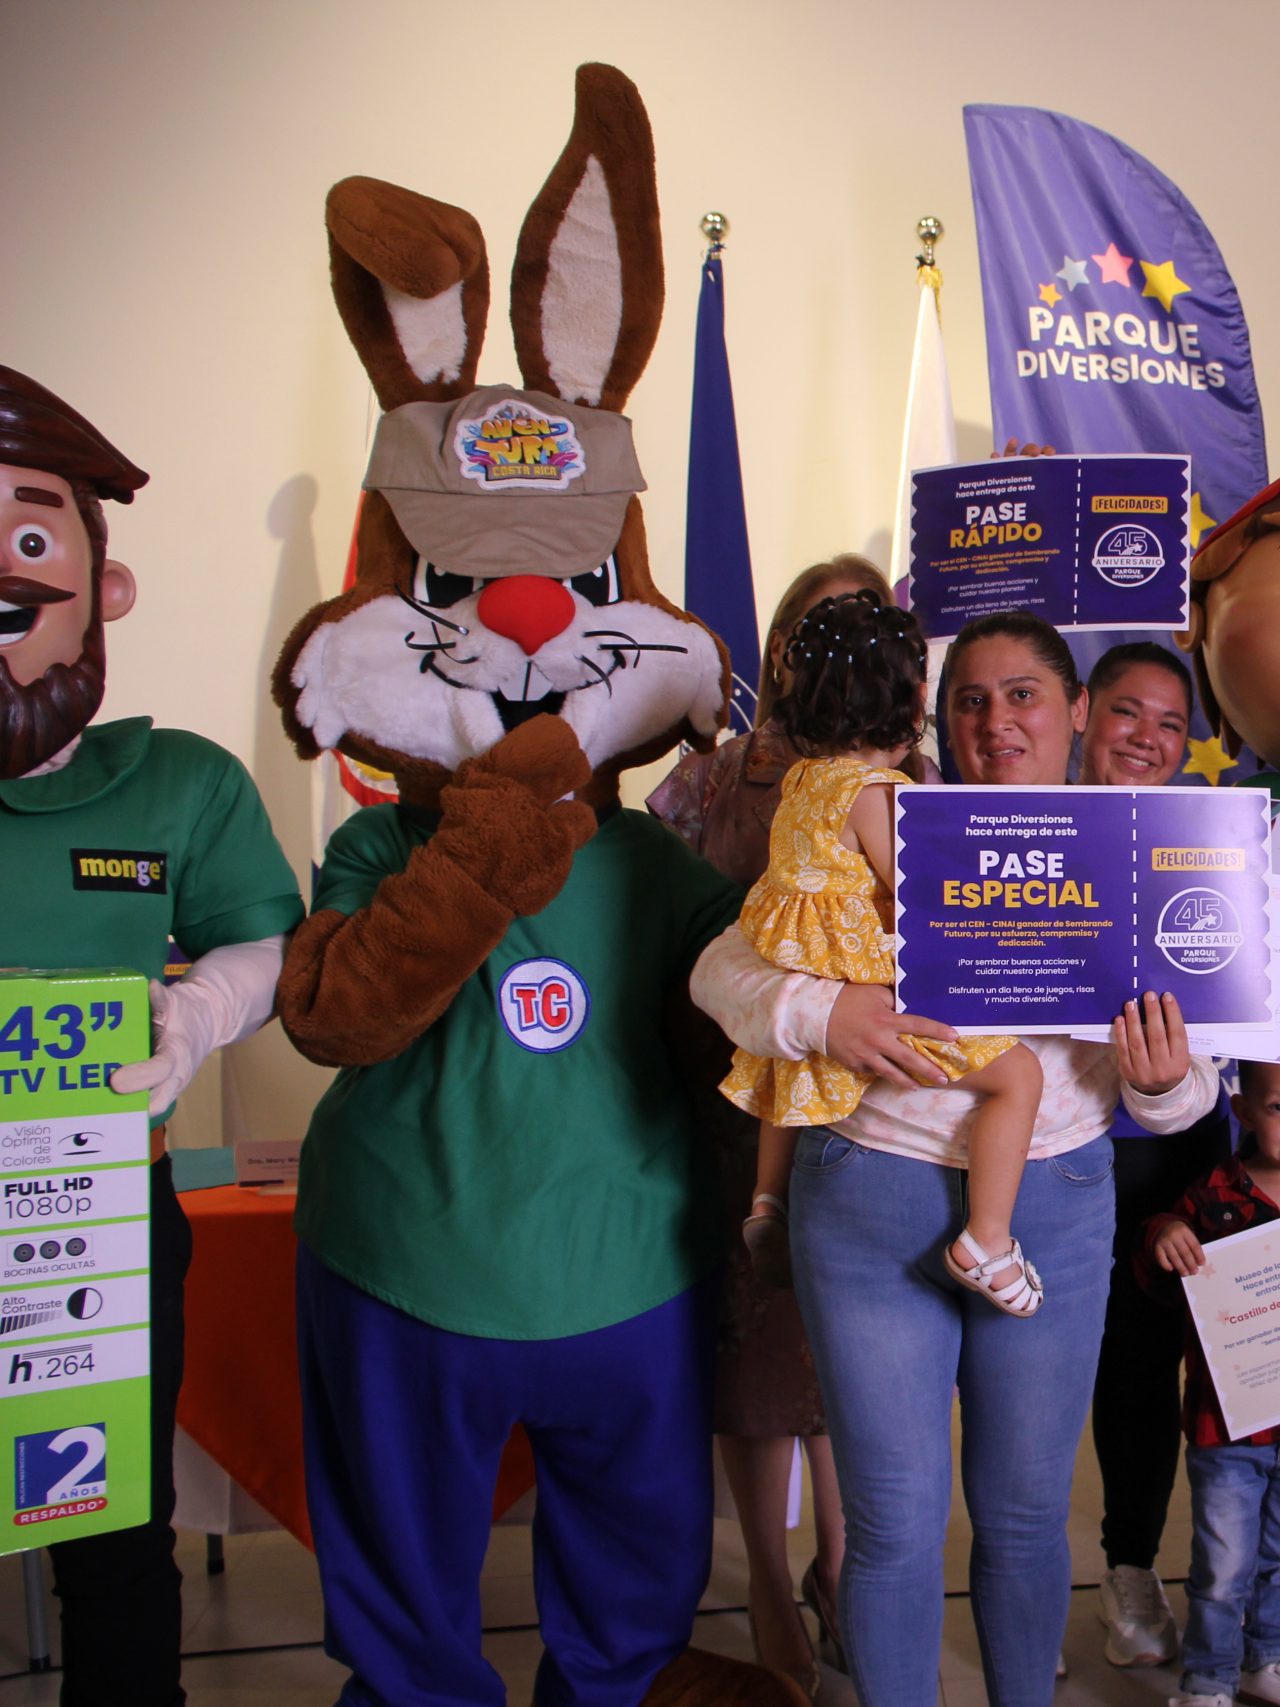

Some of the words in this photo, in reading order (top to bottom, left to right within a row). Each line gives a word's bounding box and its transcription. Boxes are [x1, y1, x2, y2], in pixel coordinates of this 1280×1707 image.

[1028, 306, 1201, 358] PARQUE
[1017, 348, 1226, 391] DIVERSIONES
[492, 465, 531, 477] COSTA
[534, 465, 558, 477] RICA
[959, 481, 986, 489] Parque
[987, 476, 1032, 486] Diversiones
[976, 487, 1006, 496] entrega
[1095, 498, 1164, 510] ¡FELICIDADES!
[966, 502, 1027, 524] PASE
[950, 522, 1042, 548] RÁPIDO
[1108, 532, 1148, 555] 45
[970, 815, 1009, 826] Parque
[1011, 814, 1073, 824] Diversiones
[966, 827, 993, 836] hace
[995, 828, 1038, 838] entrega
[1039, 827, 1053, 836] de
[1055, 828, 1077, 836] este
[979, 850, 1064, 878] PASE
[1157, 851, 1241, 867] ¡FELICIDADES!
[80, 858, 160, 886] monge
[943, 880, 1099, 908] ESPECIAL
[1175, 898, 1223, 930] 45
[1017, 921, 1052, 929] ganador
[944, 930, 974, 938] Futuro,
[1002, 930, 1039, 938] esfuerzo,
[1040, 930, 1092, 938] compromiso
[1160, 935, 1241, 944] ANIVERSARIO
[998, 939, 1046, 947] dedicación.
[958, 959, 973, 967] ¡Por
[1081, 959, 1086, 967] y
[1035, 967, 1068, 976] planeta!
[1046, 987, 1075, 995] juegos,
[511, 977, 572, 1032] TC
[1022, 995, 1059, 1003] diversión.
[0, 1067, 46, 1094] TV
[14, 1125, 51, 1137] Visión
[1, 1135, 51, 1149] Óptima
[33, 1145, 51, 1155] de
[2, 1155, 52, 1168] Colores
[5, 1180, 58, 1197] FULL
[64, 1177, 93, 1191] HD
[5, 1194, 92, 1219] 1080p
[4, 1266, 49, 1278] BOCINAS
[51, 1260, 96, 1272] OCULTAS
[1235, 1270, 1262, 1283] Museo
[1263, 1266, 1273, 1274] de
[1243, 1280, 1263, 1291] Hace
[2, 1296, 26, 1306] Alto
[2, 1300, 63, 1315] Contraste
[46, 1426, 106, 1505] 2
[60, 1486, 99, 1500] AÑOS
